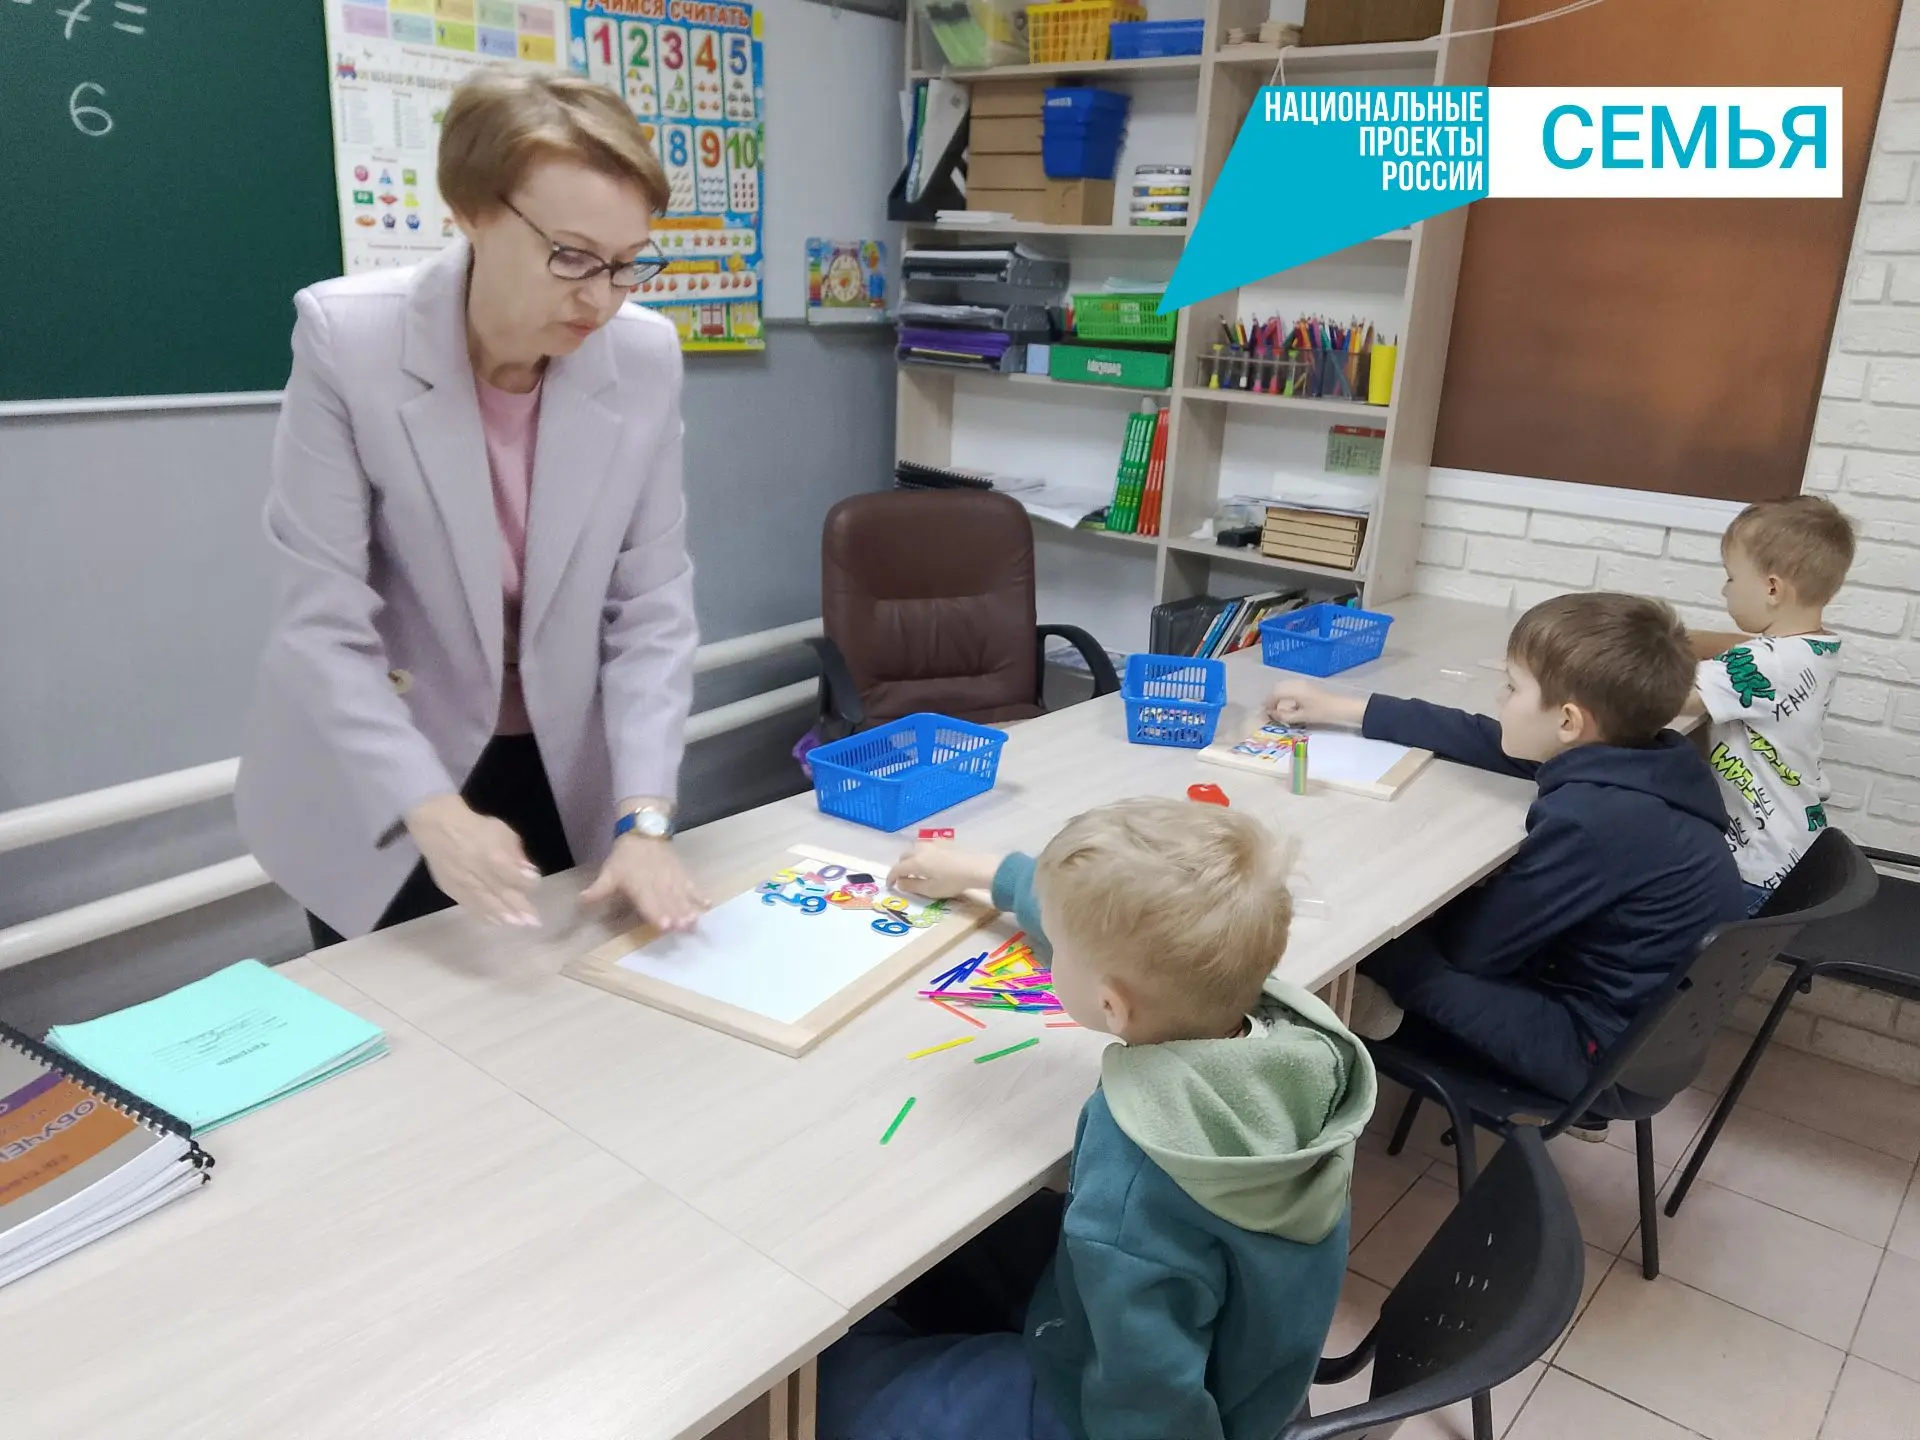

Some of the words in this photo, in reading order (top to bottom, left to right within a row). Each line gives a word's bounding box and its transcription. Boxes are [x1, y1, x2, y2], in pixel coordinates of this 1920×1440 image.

[669, 1, 750, 28] СЧИТАТЬ
[593, 22, 612, 66] 1
[628, 26, 650, 67] 2
[662, 30, 684, 71] 3
[695, 33, 717, 74] 4
[729, 37, 748, 77] 5
[69, 81, 113, 136] 6
[670, 129, 688, 167] 8
[701, 130, 721, 168] 9
[726, 131, 757, 169] 10
[1771, 667, 1819, 722] YEAH!!!
